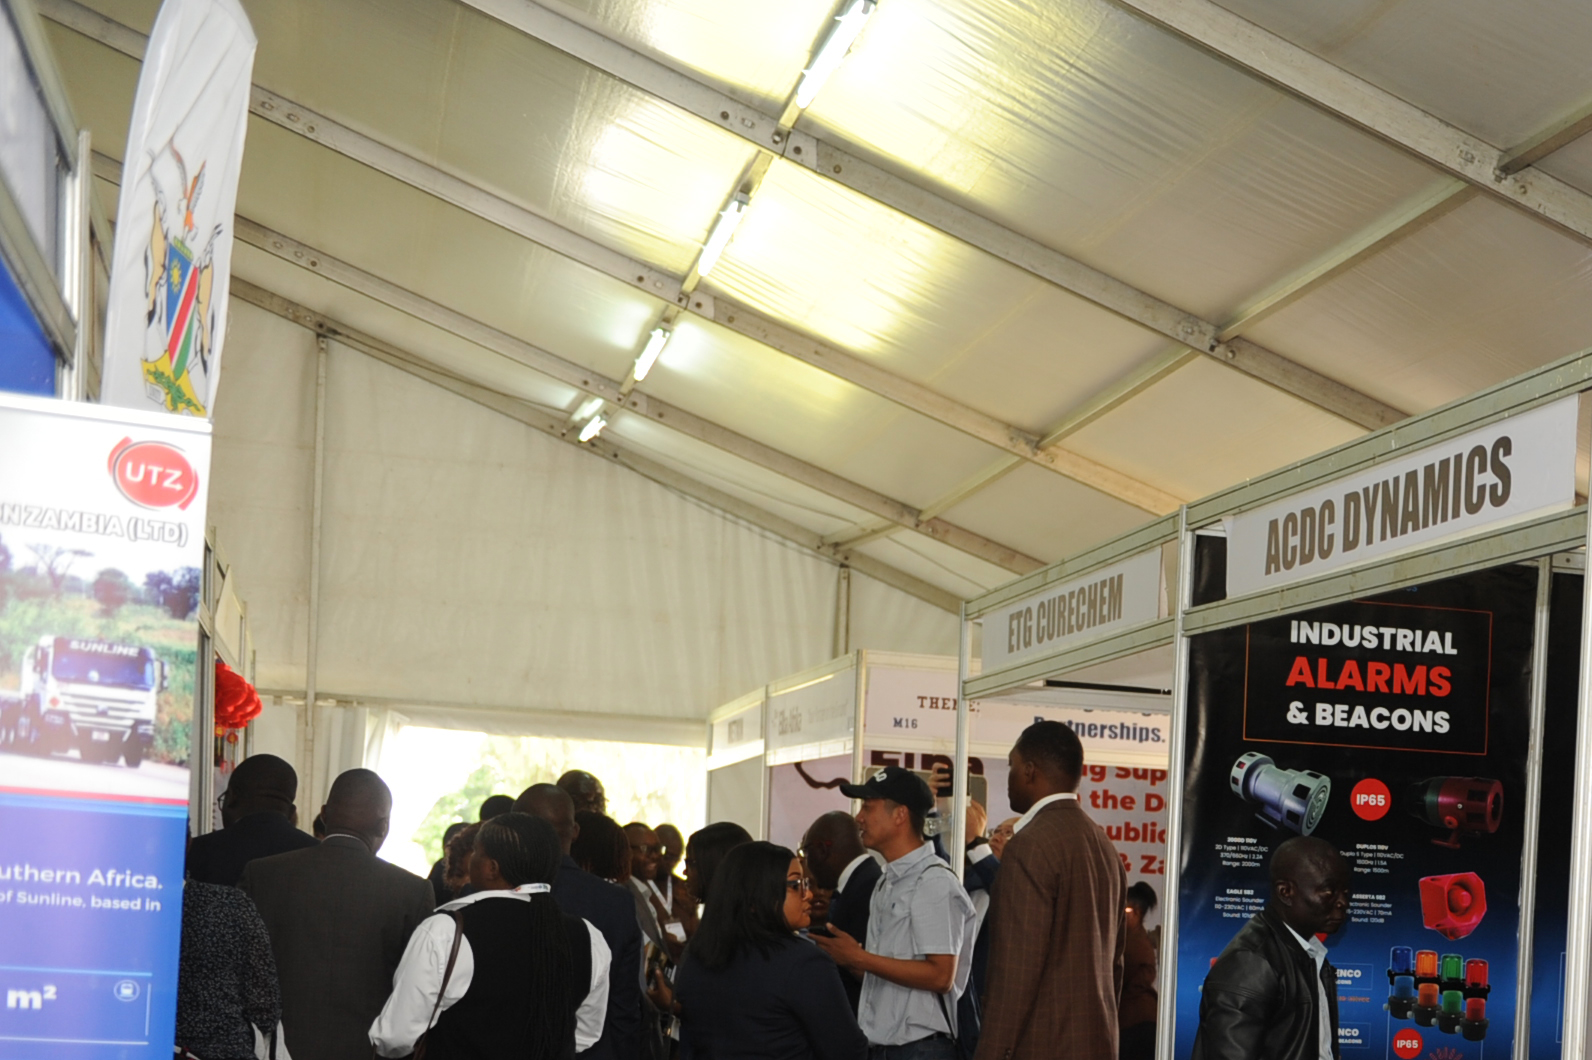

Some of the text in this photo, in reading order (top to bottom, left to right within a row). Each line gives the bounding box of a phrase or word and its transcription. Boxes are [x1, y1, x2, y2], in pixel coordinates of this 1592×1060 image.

[125, 461, 184, 491] UTZ
[1265, 435, 1513, 576] ACDC DYNAMICS
[23, 505, 125, 538] ZAMBIA
[127, 516, 189, 548] (LTD)
[1007, 572, 1124, 654] ETG CURECHEM
[69, 640, 139, 657] SUNLINE
[1290, 620, 1458, 655] INDUSTRIAL
[1285, 655, 1452, 697] ALARMS
[893, 717, 918, 729] M16
[1286, 701, 1451, 734] & BEACONS
[1090, 789, 1136, 810] the
[1356, 793, 1386, 807] IP65
[1100, 822, 1166, 844] ublic
[86, 868, 163, 889] Africa.
[16, 891, 87, 908] Sunline,
[91, 894, 141, 910] based
[145, 898, 161, 912] in
[1396, 1039, 1419, 1049] IP65
